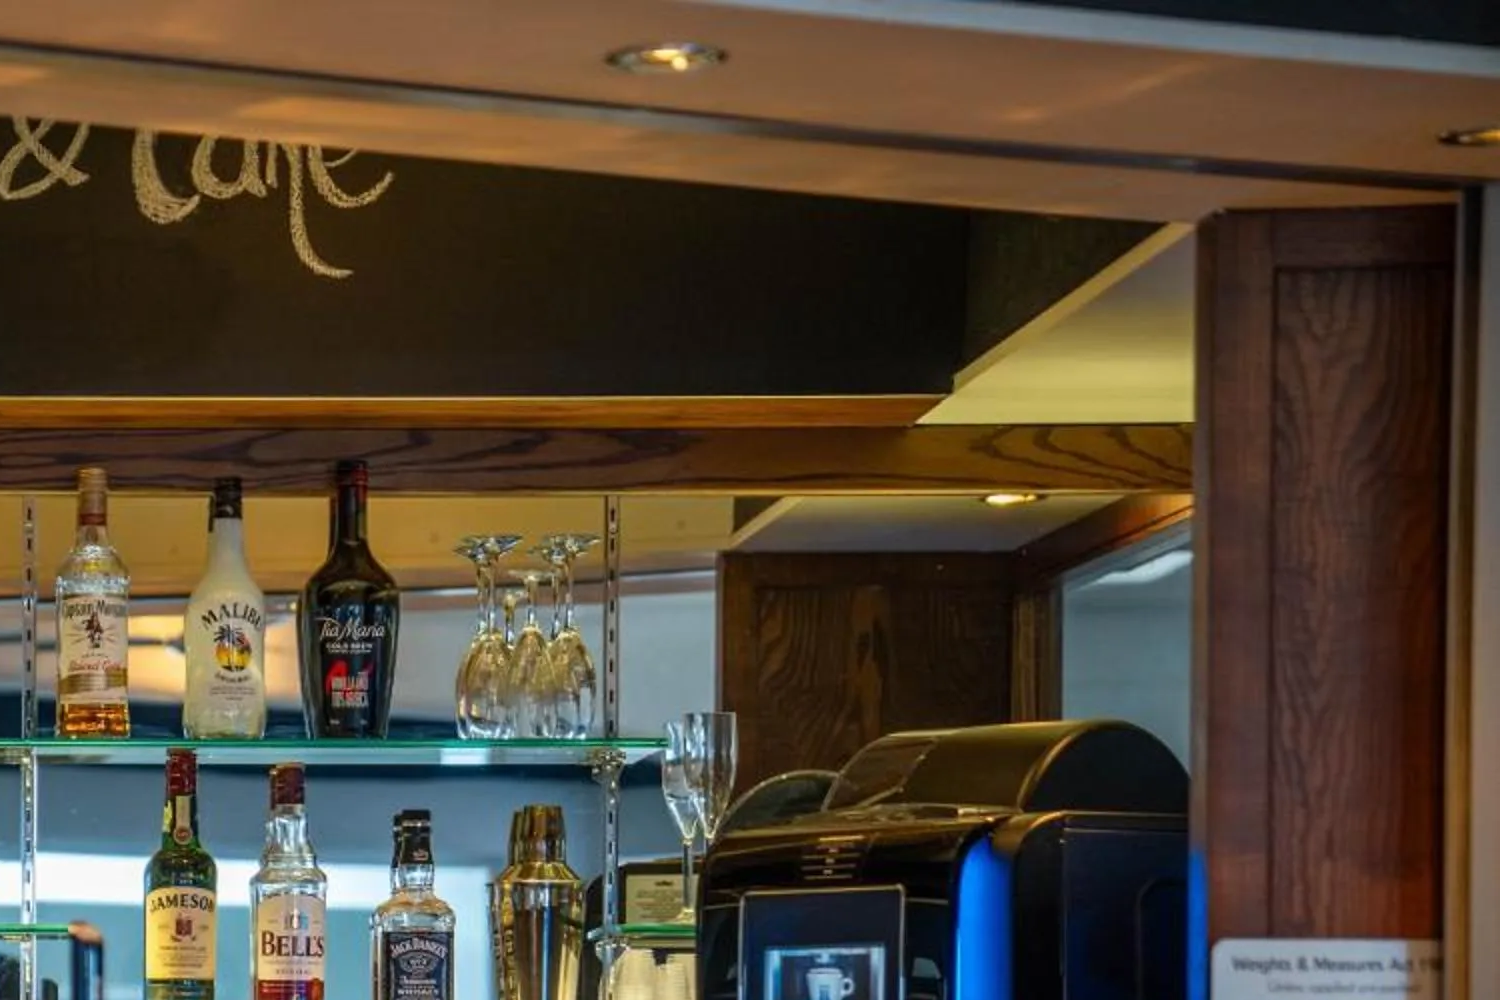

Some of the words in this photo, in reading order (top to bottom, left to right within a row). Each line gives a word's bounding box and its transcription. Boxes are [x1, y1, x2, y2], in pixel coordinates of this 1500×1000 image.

[201, 602, 265, 632] MALIBU
[315, 617, 340, 641] Tia
[339, 616, 386, 641] Maria
[150, 893, 214, 914] JAMESON
[261, 929, 325, 958] BELL'S
[1231, 954, 1291, 975] Weights
[1296, 956, 1310, 973] &
[1313, 955, 1385, 973] Measures
